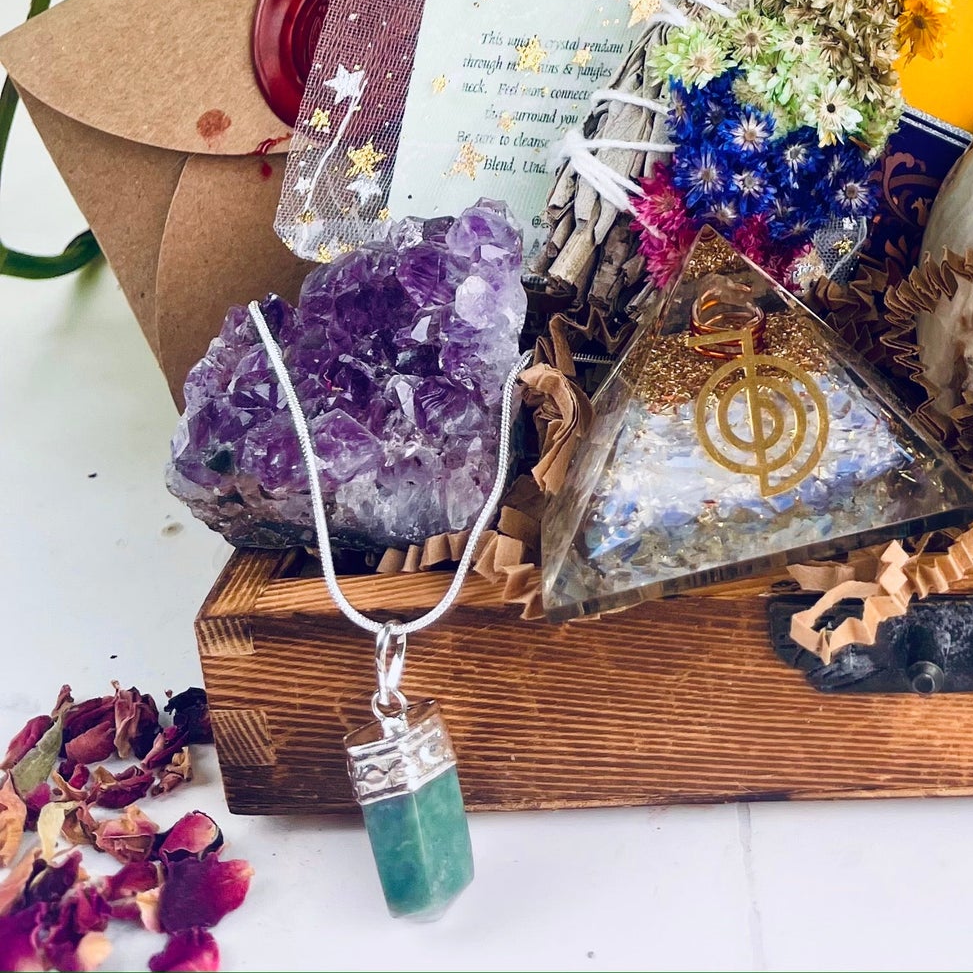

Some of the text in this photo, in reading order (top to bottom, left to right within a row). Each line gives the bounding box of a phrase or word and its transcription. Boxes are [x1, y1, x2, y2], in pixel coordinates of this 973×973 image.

[481, 31, 503, 46] This
[463, 55, 502, 76] through
[562, 63, 573, 75] &
[577, 63, 612, 83] jungles
[462, 78, 488, 95] neck.
[556, 115, 579, 130] you
[499, 134, 510, 146] to
[513, 132, 549, 148] cleanse
[484, 154, 517, 175] Blend,
